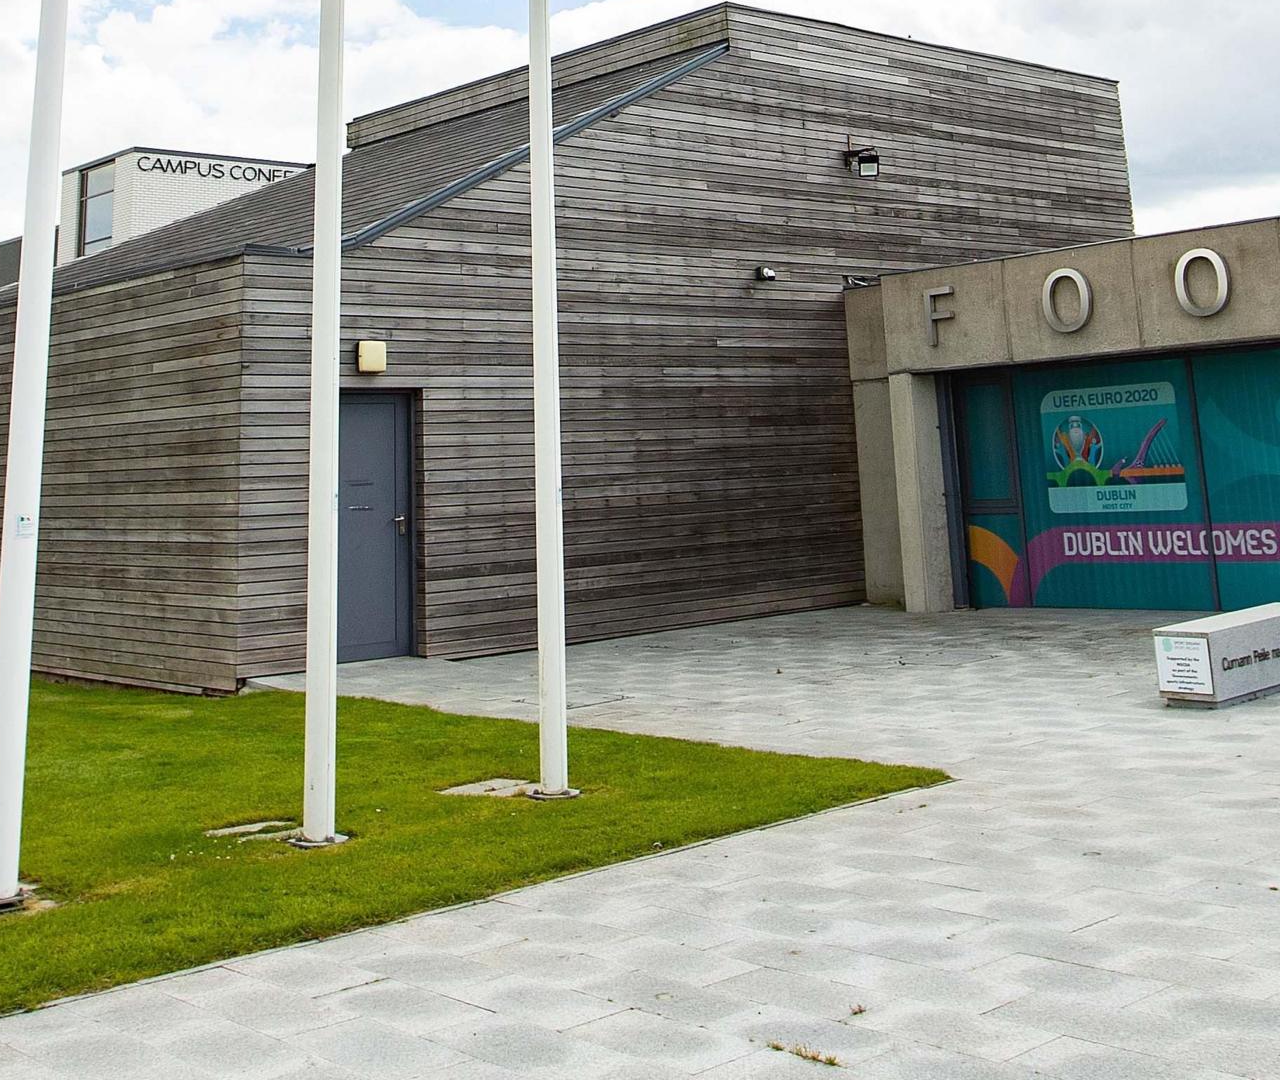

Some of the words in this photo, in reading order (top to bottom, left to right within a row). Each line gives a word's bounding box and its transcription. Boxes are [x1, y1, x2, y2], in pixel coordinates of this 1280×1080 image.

[137, 156, 225, 179] CAMPUS
[1053, 393, 1087, 408] UEFA
[1088, 390, 1123, 406] EURO
[1124, 388, 1159, 403] 2020
[1096, 489, 1137, 501] DUBLIN
[1063, 531, 1144, 556] DUBLIN
[1148, 529, 1278, 556] WELCOMES
[1222, 655, 1253, 671] Cumann
